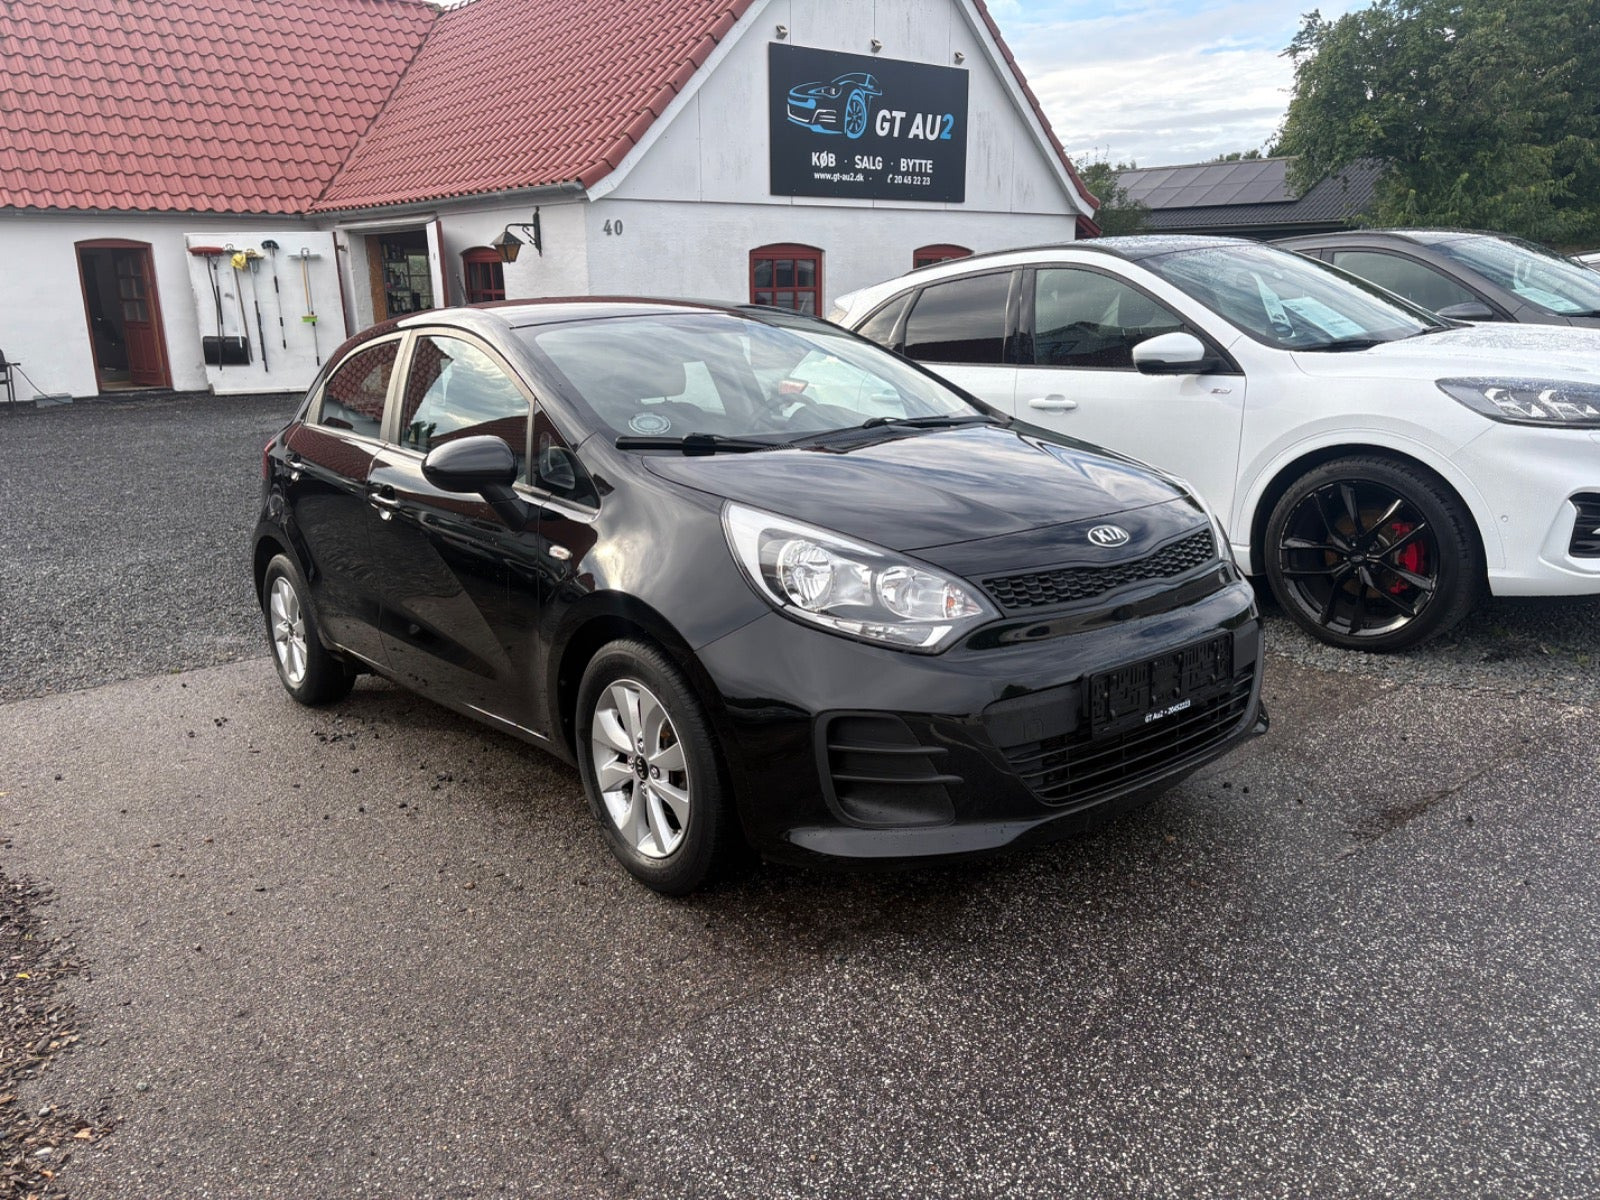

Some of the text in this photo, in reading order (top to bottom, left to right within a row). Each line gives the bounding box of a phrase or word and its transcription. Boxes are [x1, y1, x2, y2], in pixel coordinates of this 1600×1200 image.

[875, 109, 954, 141] GT AU2
[811, 151, 933, 173] KØB SALG BYTTE
[813, 172, 931, 186] www.gt-au2.dk 20 45 22 23
[603, 219, 624, 236] 40
[1093, 527, 1127, 543] KIA
